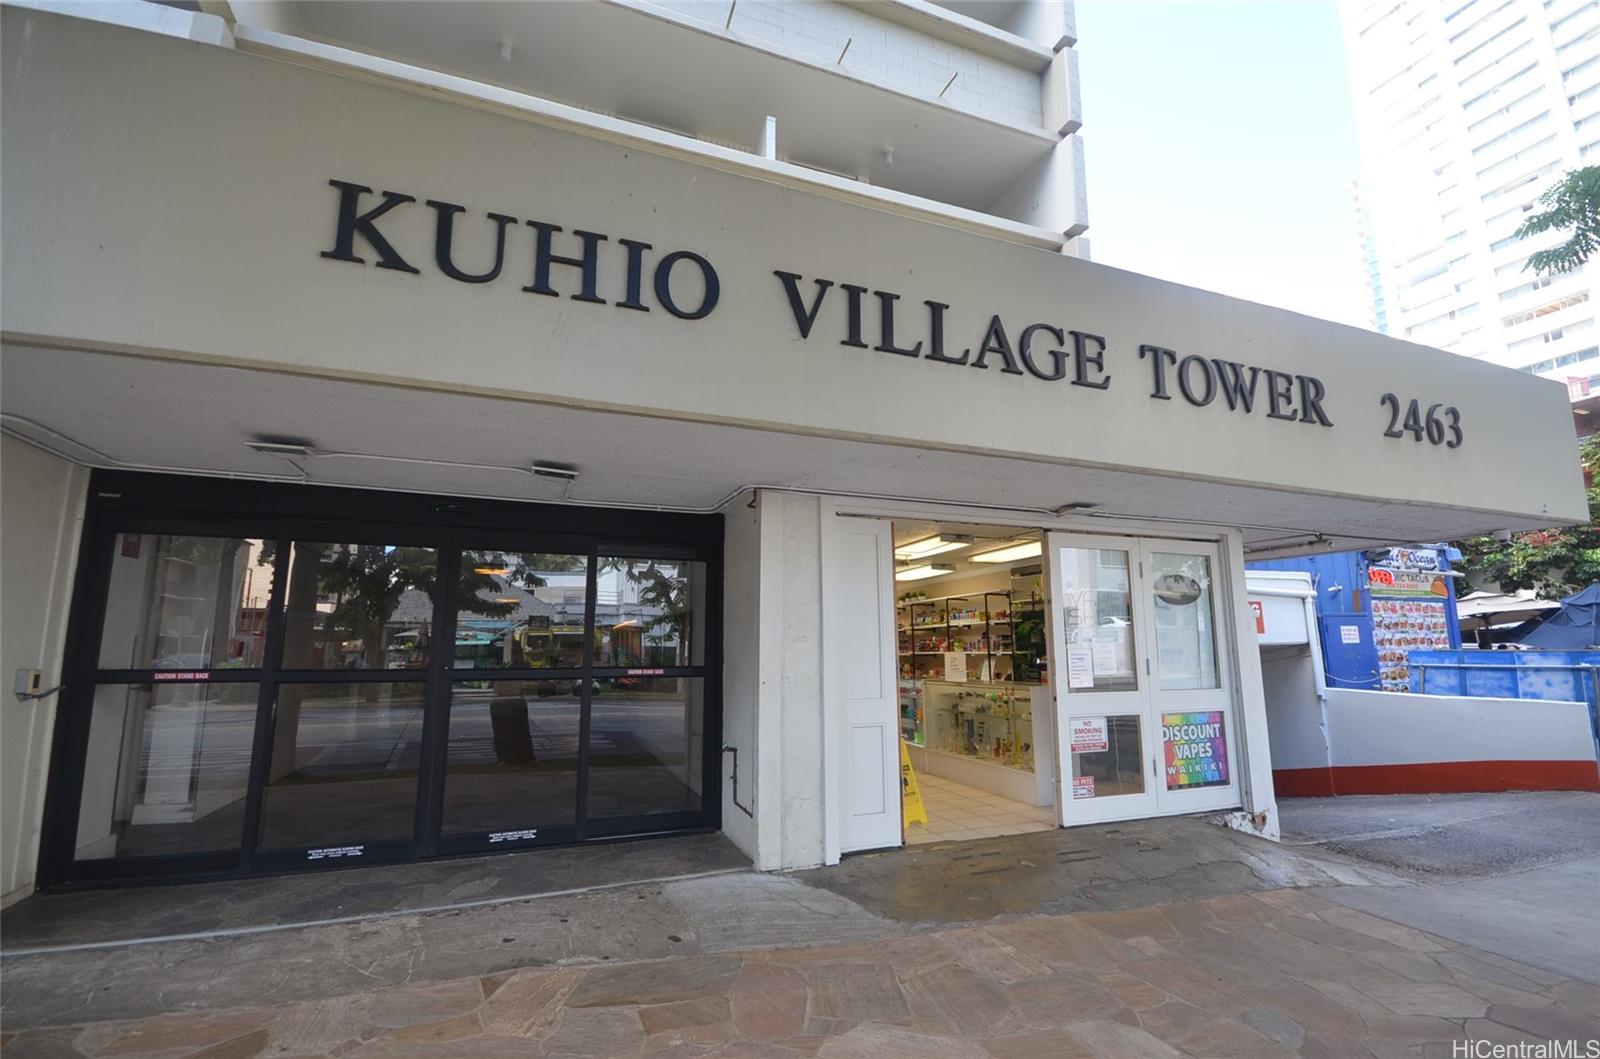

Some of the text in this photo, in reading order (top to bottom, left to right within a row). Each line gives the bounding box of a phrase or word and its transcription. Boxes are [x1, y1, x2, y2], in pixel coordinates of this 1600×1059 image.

[320, 178, 1463, 449] KUHIO VILLAGE TOWER 2463
[1406, 574, 1429, 583] TACOS
[1073, 727, 1103, 735] SMOKING
[1161, 723, 1220, 741] DISCOUNT
[1175, 742, 1212, 759] VAPES
